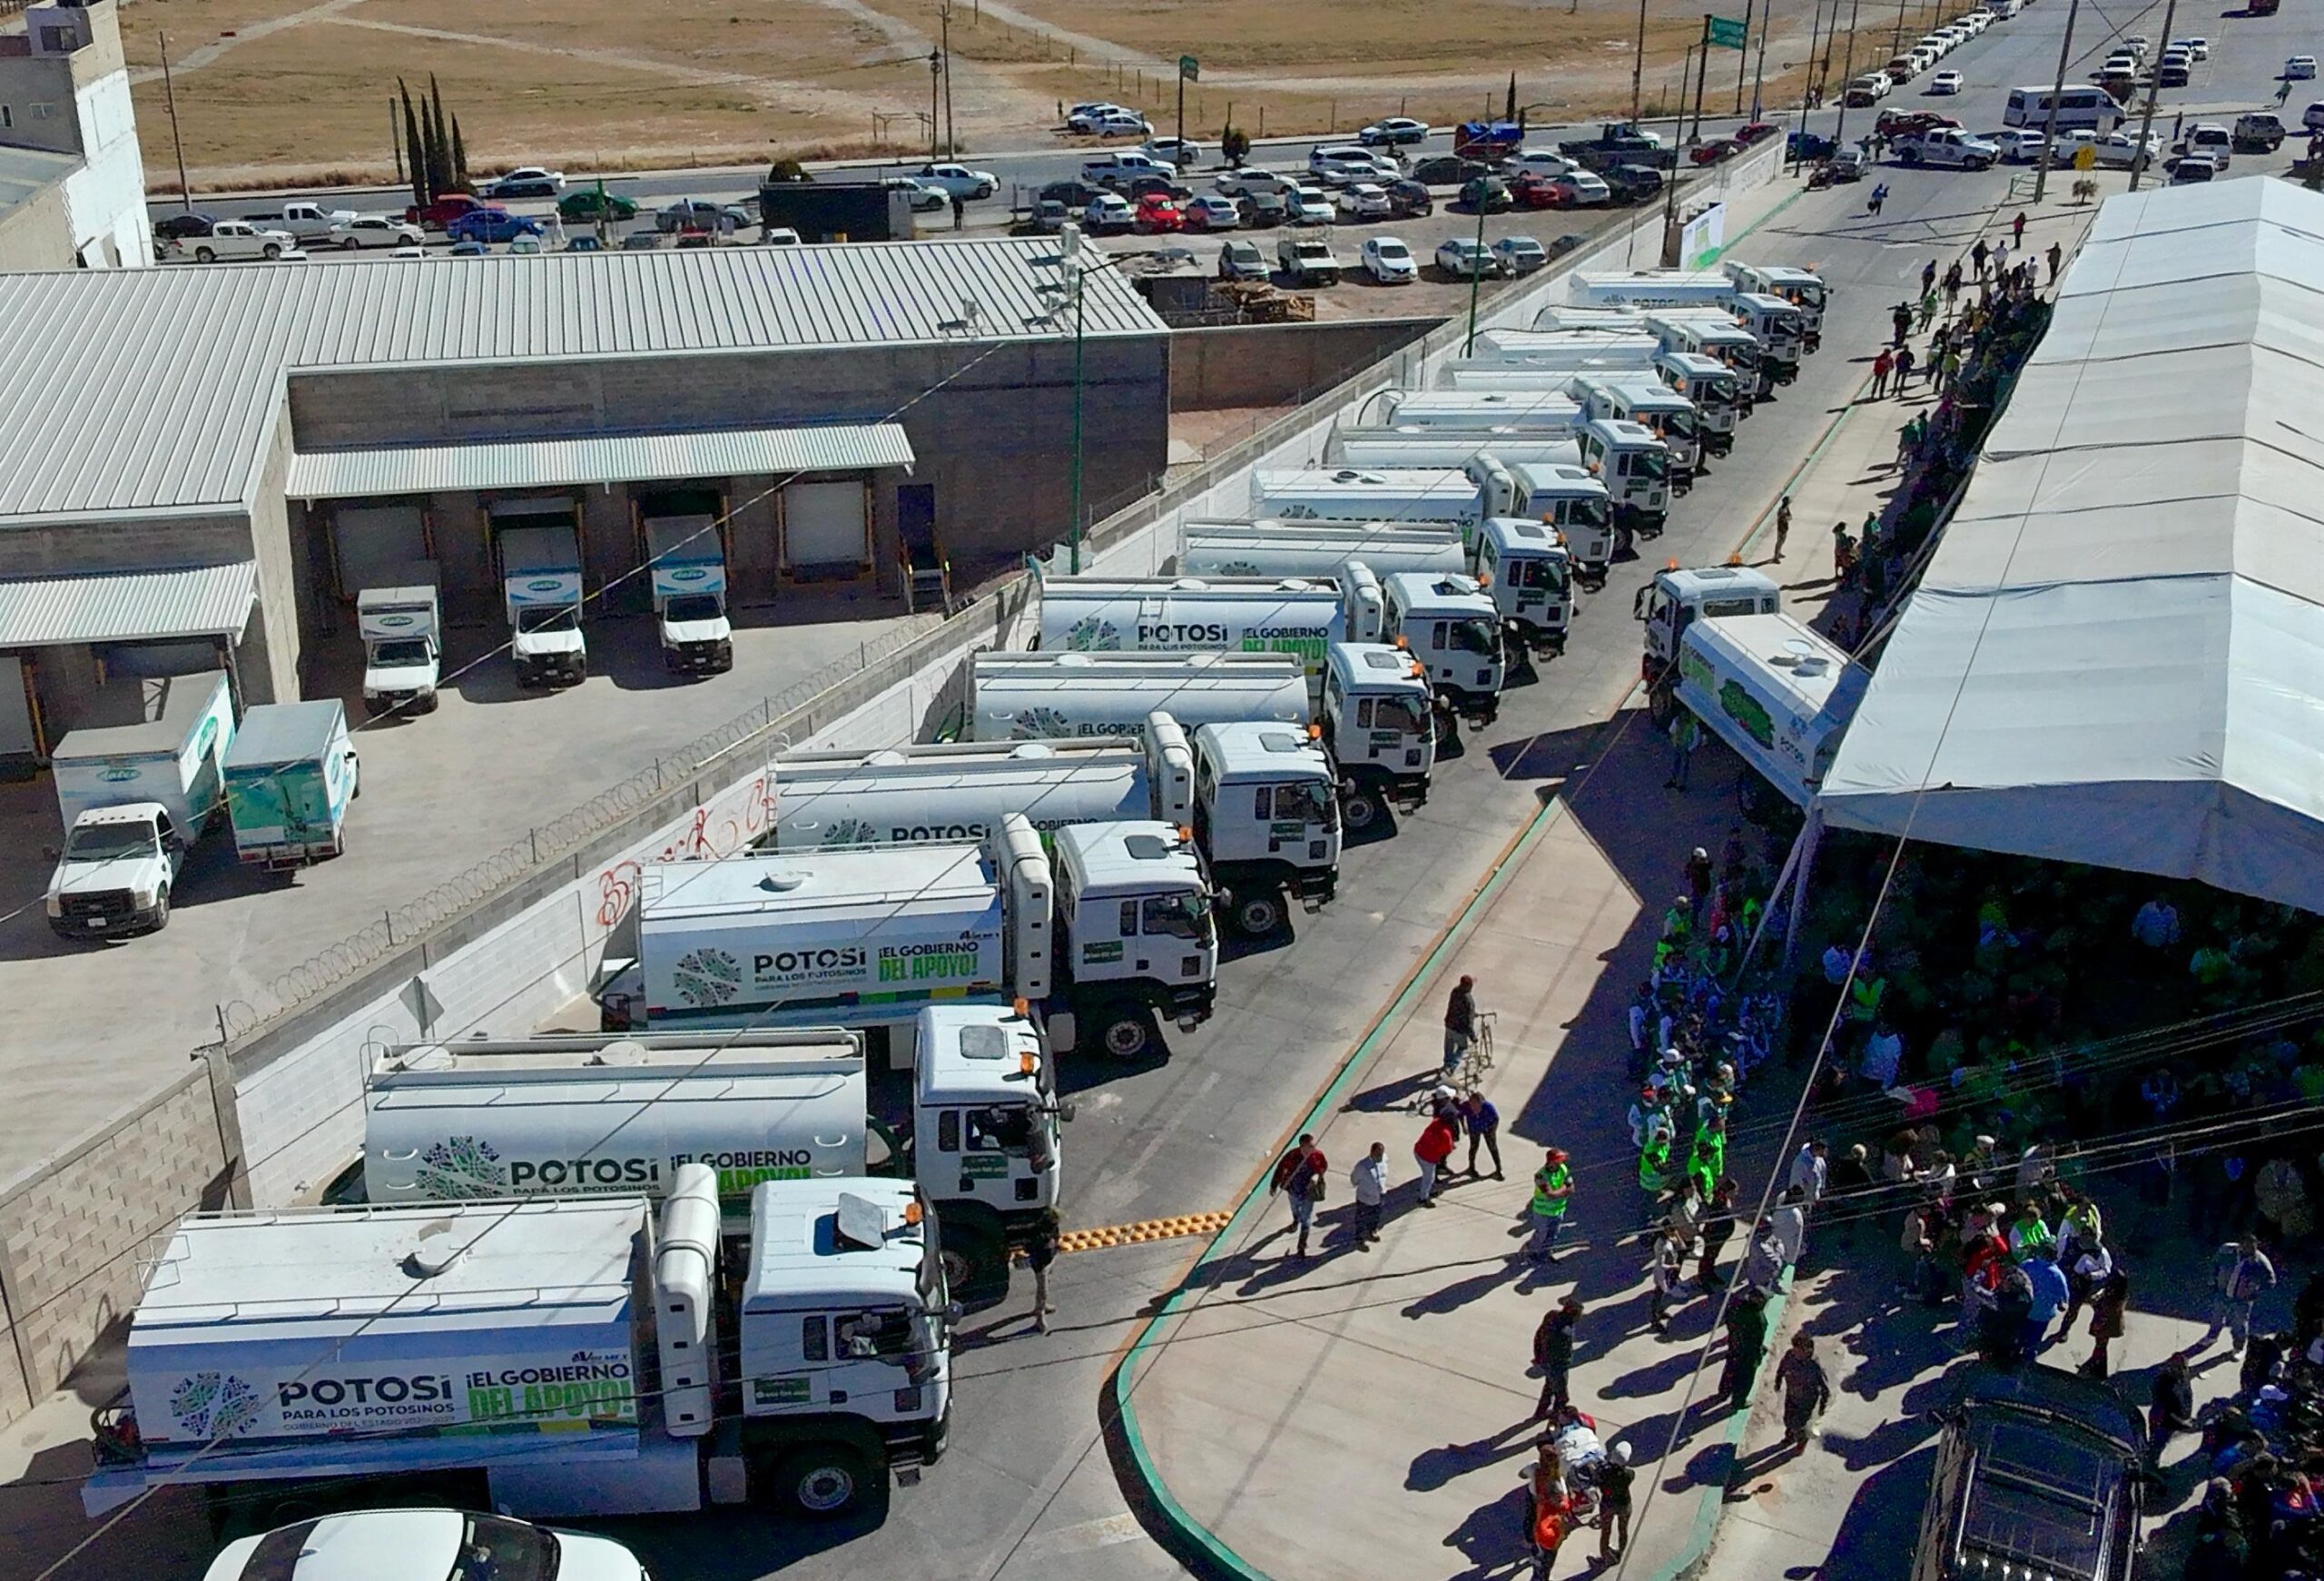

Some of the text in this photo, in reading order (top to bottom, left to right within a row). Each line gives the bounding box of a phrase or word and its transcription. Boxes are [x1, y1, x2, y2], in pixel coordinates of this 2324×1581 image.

[1260, 627, 1328, 638] GOBIERNO
[1097, 723, 1146, 735] GOBIER
[900, 942, 979, 956] GOBIERNO
[879, 954, 978, 982] DEL APOYO!
[785, 973, 806, 981] LOS
[699, 1150, 812, 1168] GOBIERNO
[513, 1183, 660, 1195] PARA LOS POTOSINOS
[466, 1363, 629, 1388] ¡EL GOBIERNO
[468, 1379, 634, 1422] DEL APOYO!
[282, 1403, 455, 1420] PARA LOS POTOSINOS
